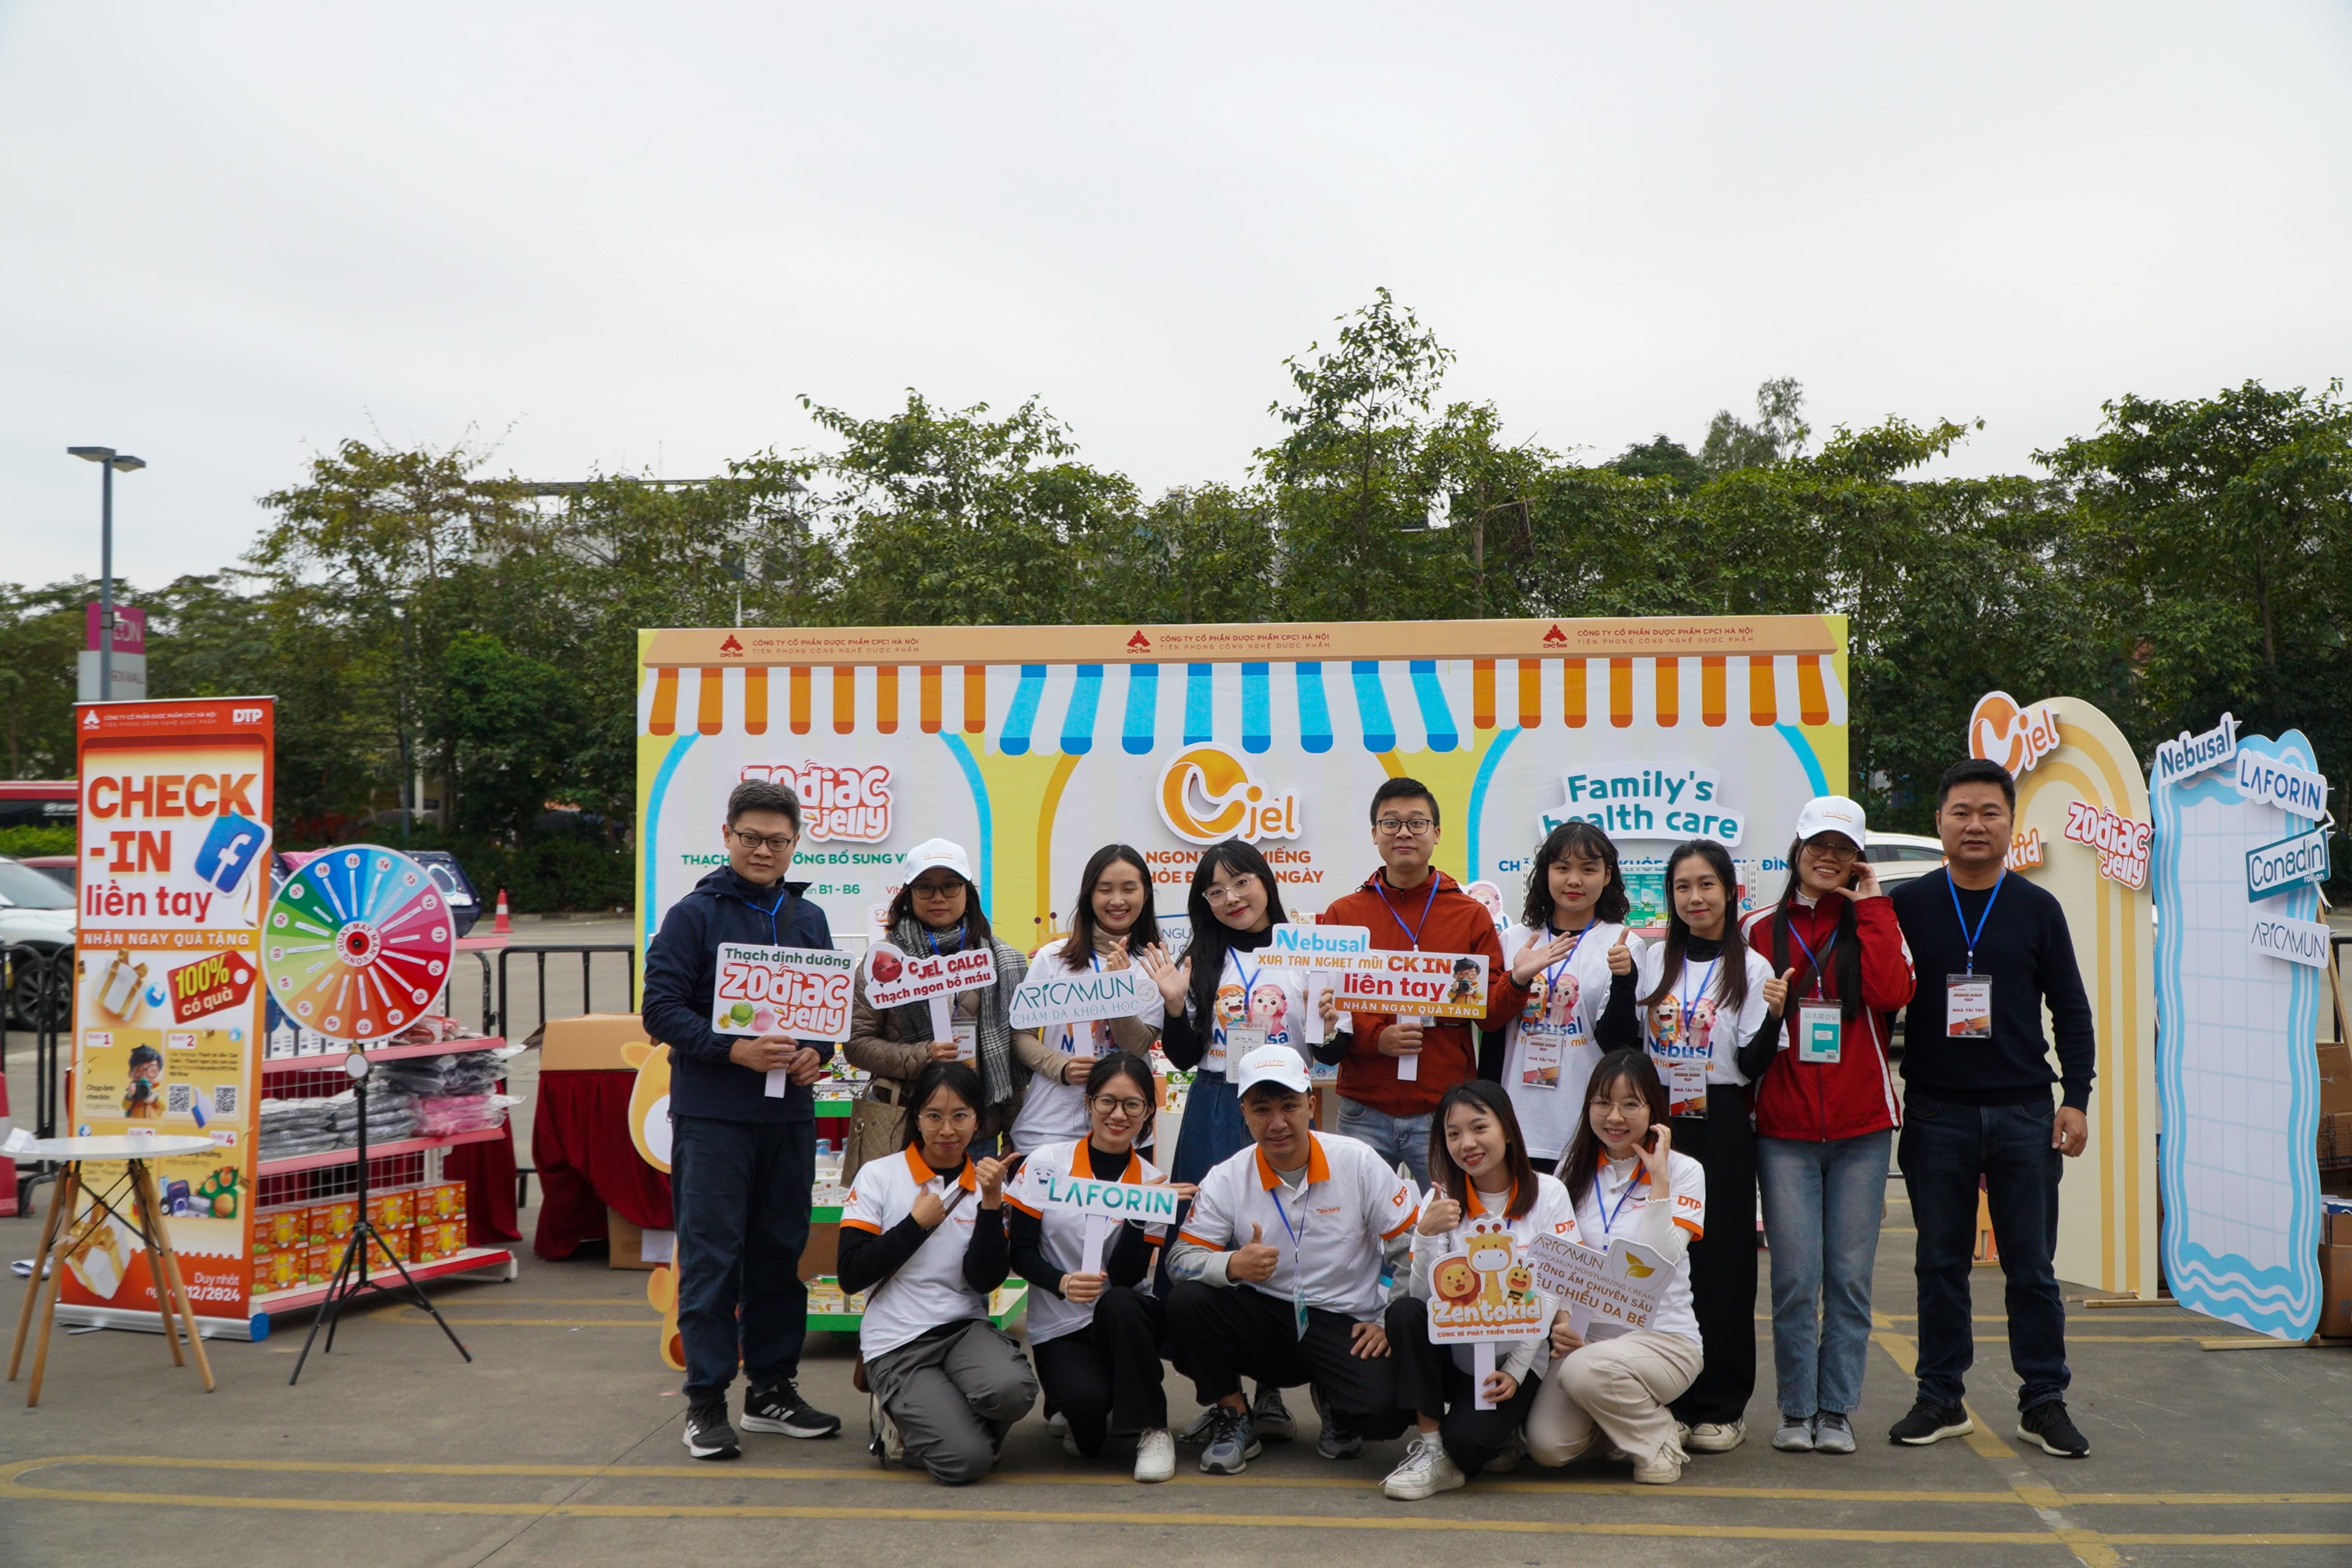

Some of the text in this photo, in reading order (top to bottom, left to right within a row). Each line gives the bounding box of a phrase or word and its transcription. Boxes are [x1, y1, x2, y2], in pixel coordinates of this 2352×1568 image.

[233, 709, 263, 723] DTP
[2160, 720, 2233, 778] Nebusal
[88, 774, 258, 818] CHECK
[1567, 771, 1713, 805] Family's
[2241, 758, 2321, 811] LAFORIN
[813, 807, 888, 837] jelly
[1666, 811, 1738, 839] care
[91, 831, 171, 872] -IN
[682, 855, 729, 865] THẠCH
[793, 851, 825, 864] ỠNG
[829, 849, 849, 864] BỔ
[852, 854, 892, 864] SUNG
[1146, 851, 1197, 864] NGON
[1762, 856, 1790, 871] ĐÌN
[1275, 867, 1324, 883] NGÀY
[2100, 852, 2146, 888] jelly
[86, 880, 213, 923] liền tay
[819, 884, 832, 894] B1
[843, 884, 860, 894] B6
[84, 932, 123, 947] NHẬN
[128, 933, 169, 945] NGAY
[207, 932, 249, 947] TẶNG
[337, 923, 372, 951] QUAY MAY
[1276, 928, 1366, 952] Nebusal
[725, 948, 769, 963] Thạch
[806, 953, 851, 970] dưỡng
[947, 953, 988, 973] CALCI
[1257, 954, 1283, 965] XUA
[1288, 956, 1310, 967] TAN
[1315, 957, 1352, 971] NGHẸT
[1423, 959, 1451, 974] IN
[175, 954, 229, 1000] 100%
[873, 971, 991, 1004] Thạch ngon bổ máu
[1400, 978, 1446, 1002] tay
[182, 987, 233, 1017] có quà
[1012, 974, 1135, 1011] ARICAMUN
[778, 1006, 845, 1035] jelly
[1054, 1011, 1068, 1020] DA
[1073, 1005, 1106, 1017] KHOA
[1343, 1001, 1377, 1012] NHẬN
[1448, 1006, 1480, 1017] TẶNG
[103, 1034, 111, 1045] 1
[187, 1035, 194, 1047] 2
[226, 1134, 234, 1146] 4
[1049, 1177, 1174, 1215] LAFORIN
[1678, 1195, 1702, 1211] DTP
[1555, 1219, 1575, 1234] DTP
[1534, 1237, 1604, 1271] ARICAMUN
[195, 1272, 214, 1286] Duy
[1533, 1250, 1572, 1270] ARICAMUN
[1574, 1266, 1626, 1291] MOISTURIZING
[1556, 1284, 1599, 1308] CHIỀU
[1602, 1302, 1621, 1318] DA
[1567, 1272, 1653, 1313] ẨM CHUYÊN SÂU
[1433, 1296, 1542, 1328] Zentokid
